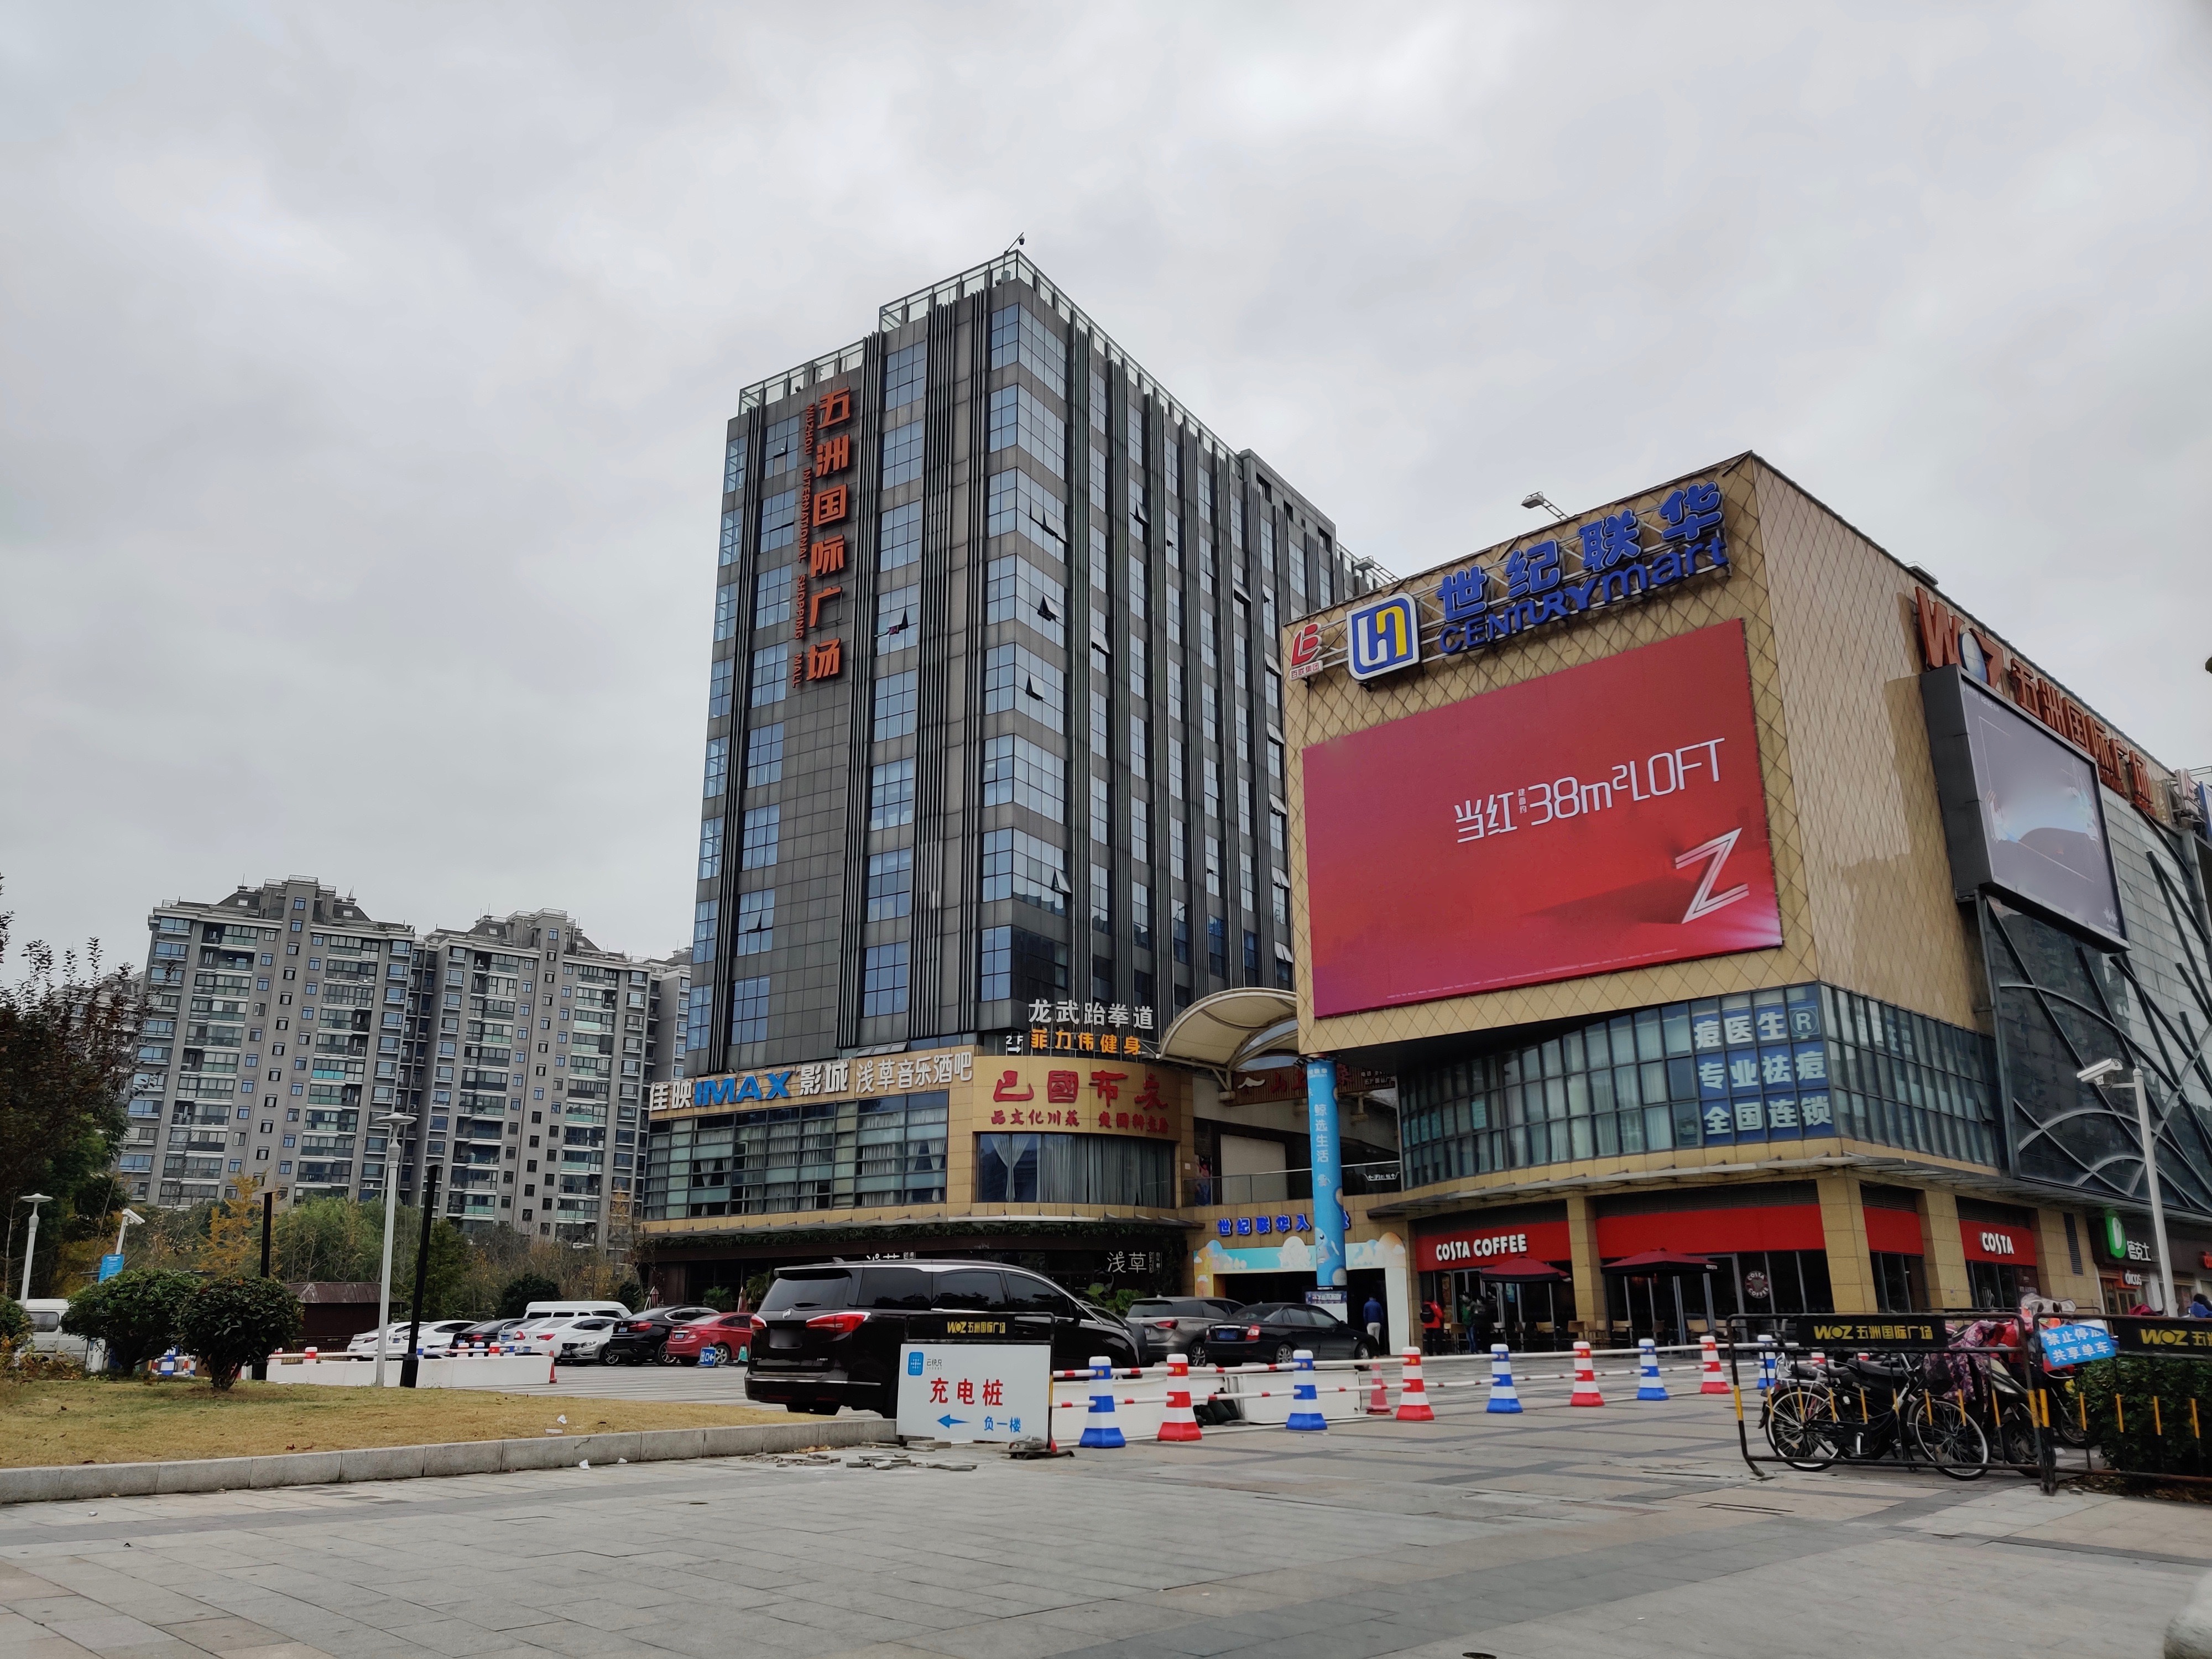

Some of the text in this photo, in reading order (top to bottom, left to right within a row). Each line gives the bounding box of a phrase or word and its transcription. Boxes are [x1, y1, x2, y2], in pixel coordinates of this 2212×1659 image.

[792, 403, 815, 687] WUZHOU INTERNATIONAL SHOPPING MALL
[806, 386, 851, 681] 五洲国际广场
[1437, 481, 1724, 622] 世纪联华
[1291, 662, 1319, 679] 百联集团
[2010, 658, 2153, 804] 五洲国际广场
[1454, 791, 1517, 843] 当红
[1029, 999, 1154, 1029] 龙武跆拳道
[1031, 1029, 1141, 1055] 菲力伟健身
[856, 1052, 972, 1093] 浅草音乐酒吧
[1699, 1051, 1826, 1089] 专业祛痘
[1704, 1095, 1833, 1135] 全国连锁
[1436, 1234, 1527, 1261] COSTA COFFEE
[1982, 1232, 2015, 1254] COSTA
[1107, 1251, 1147, 1273] 浅草
[968, 1322, 1005, 1334] 五洲国际广场
[1856, 1326, 1933, 1339] 五洲国际广场
[2053, 1341, 2110, 1363] 共享单车
[930, 1378, 1003, 1406] 充电桩
[984, 1416, 1021, 1433] 负一楼
